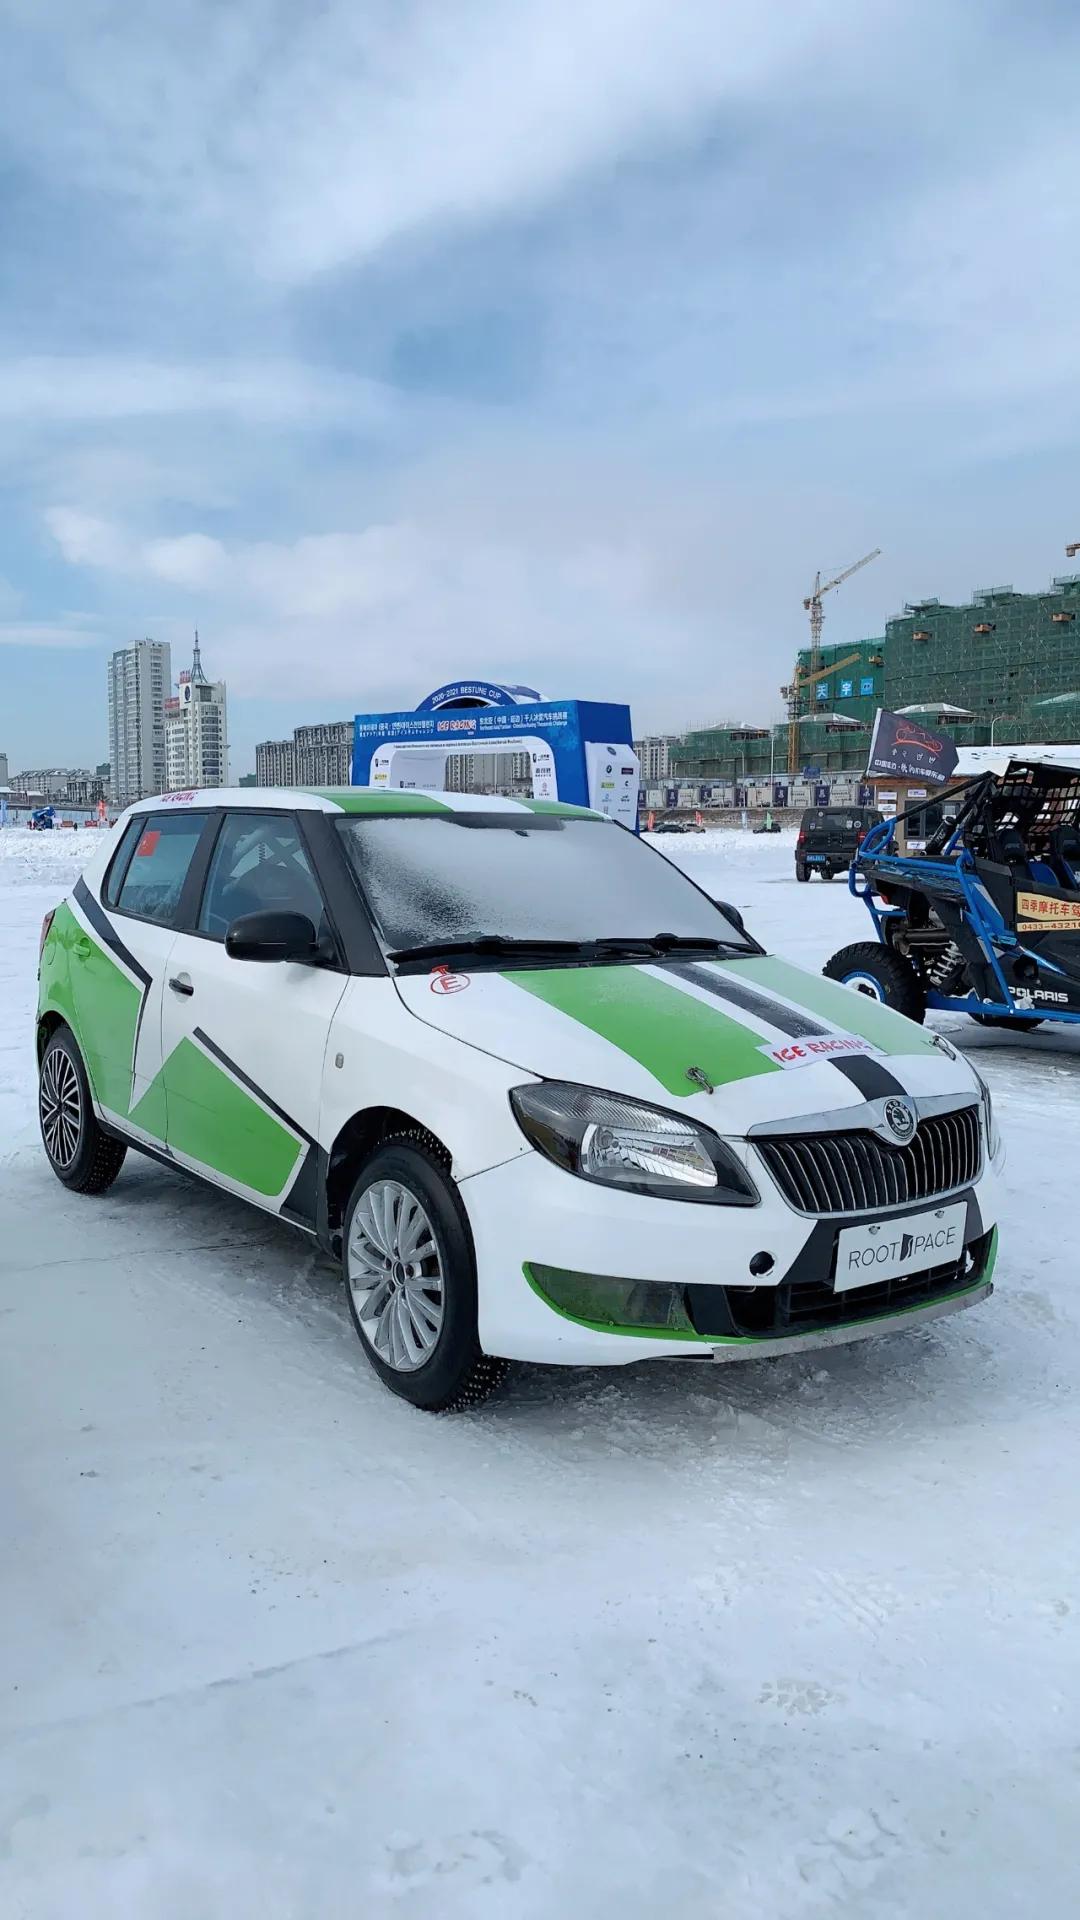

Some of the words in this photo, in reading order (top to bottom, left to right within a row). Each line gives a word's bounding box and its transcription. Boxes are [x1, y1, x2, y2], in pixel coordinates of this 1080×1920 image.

[488, 690, 501, 699] CUP
[1008, 986, 1069, 1003] POLARIS
[772, 1045, 807, 1062] ICE
